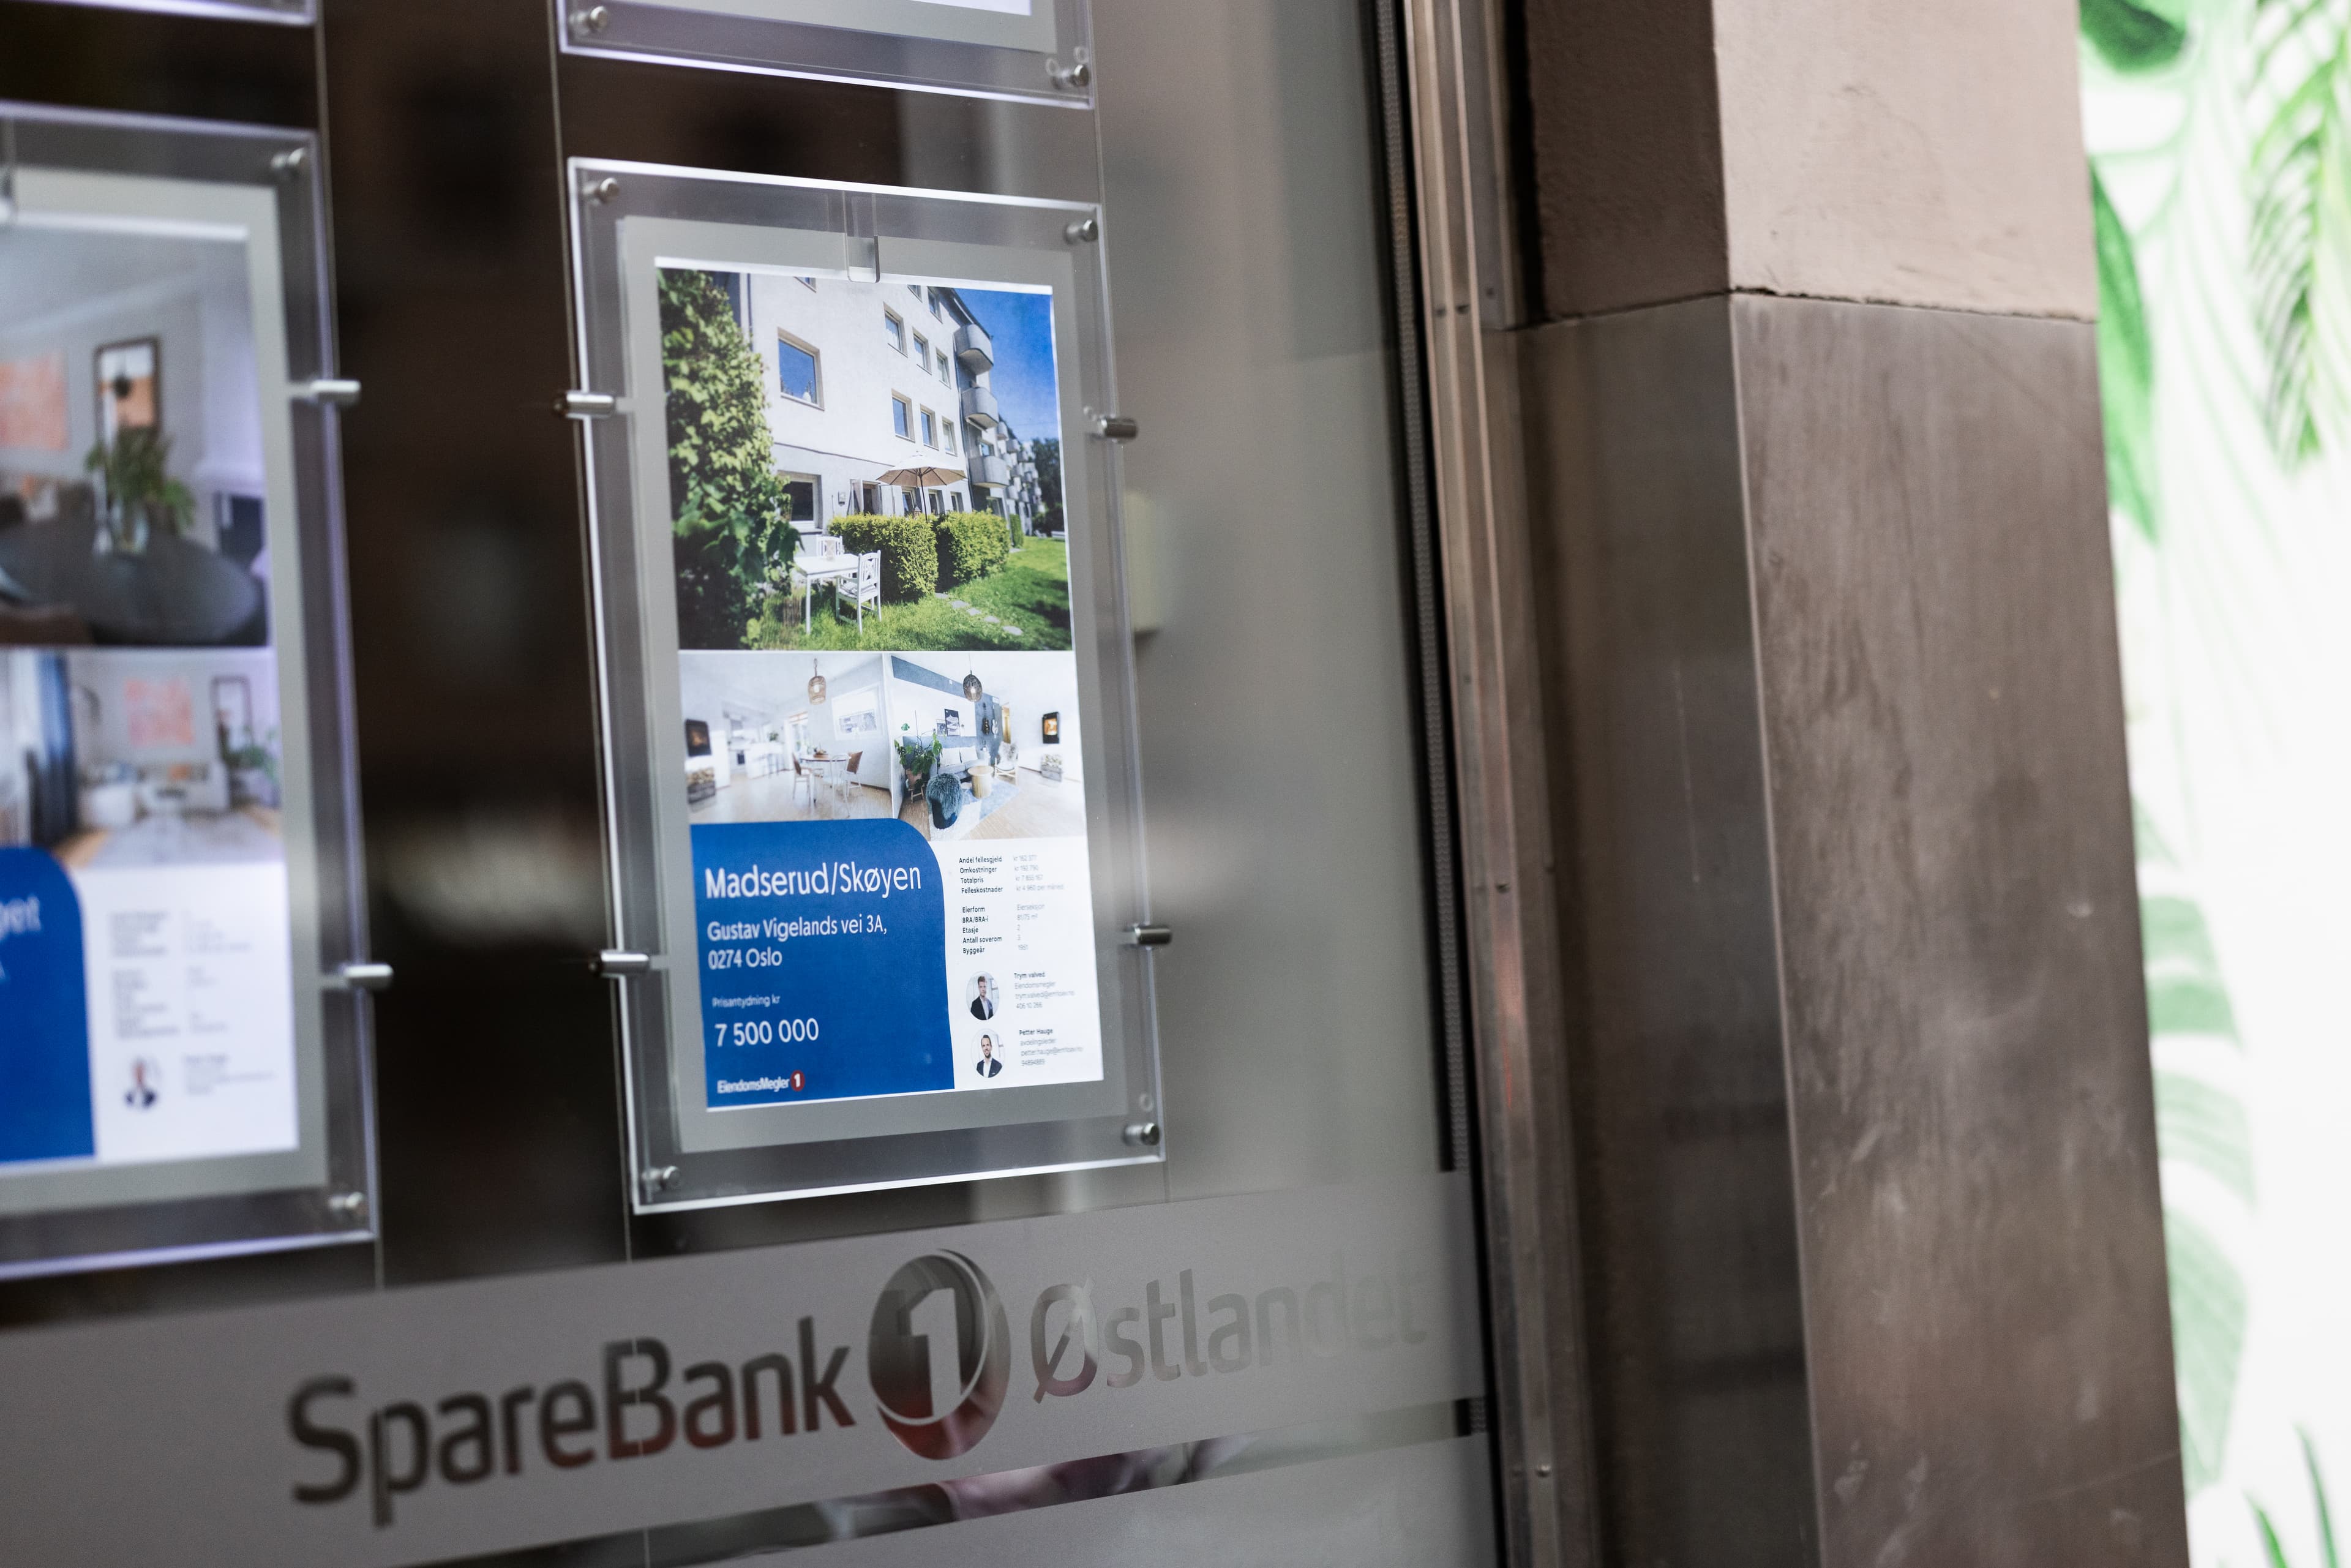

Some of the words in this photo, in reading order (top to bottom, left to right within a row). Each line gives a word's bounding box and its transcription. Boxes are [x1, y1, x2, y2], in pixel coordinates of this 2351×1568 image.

[705, 861, 921, 898] Madserud/Skøyen
[707, 920, 760, 941] Gustav
[762, 915, 838, 942] Vigelands
[841, 913, 863, 934] vei
[866, 914, 887, 934] 3A,
[708, 949, 742, 970] 0274
[746, 947, 782, 967] Oslo
[962, 947, 985, 955] Byggeår
[712, 996, 771, 1009] Prisantydning
[771, 994, 781, 1004] kr
[714, 1023, 727, 1047] 7
[733, 1020, 773, 1046] 500
[778, 1018, 819, 1043] 000
[717, 1077, 790, 1093] EiendomsMegler
[288, 1315, 857, 1529] SpareBank
[1029, 1250, 1428, 1404] Østlandet
